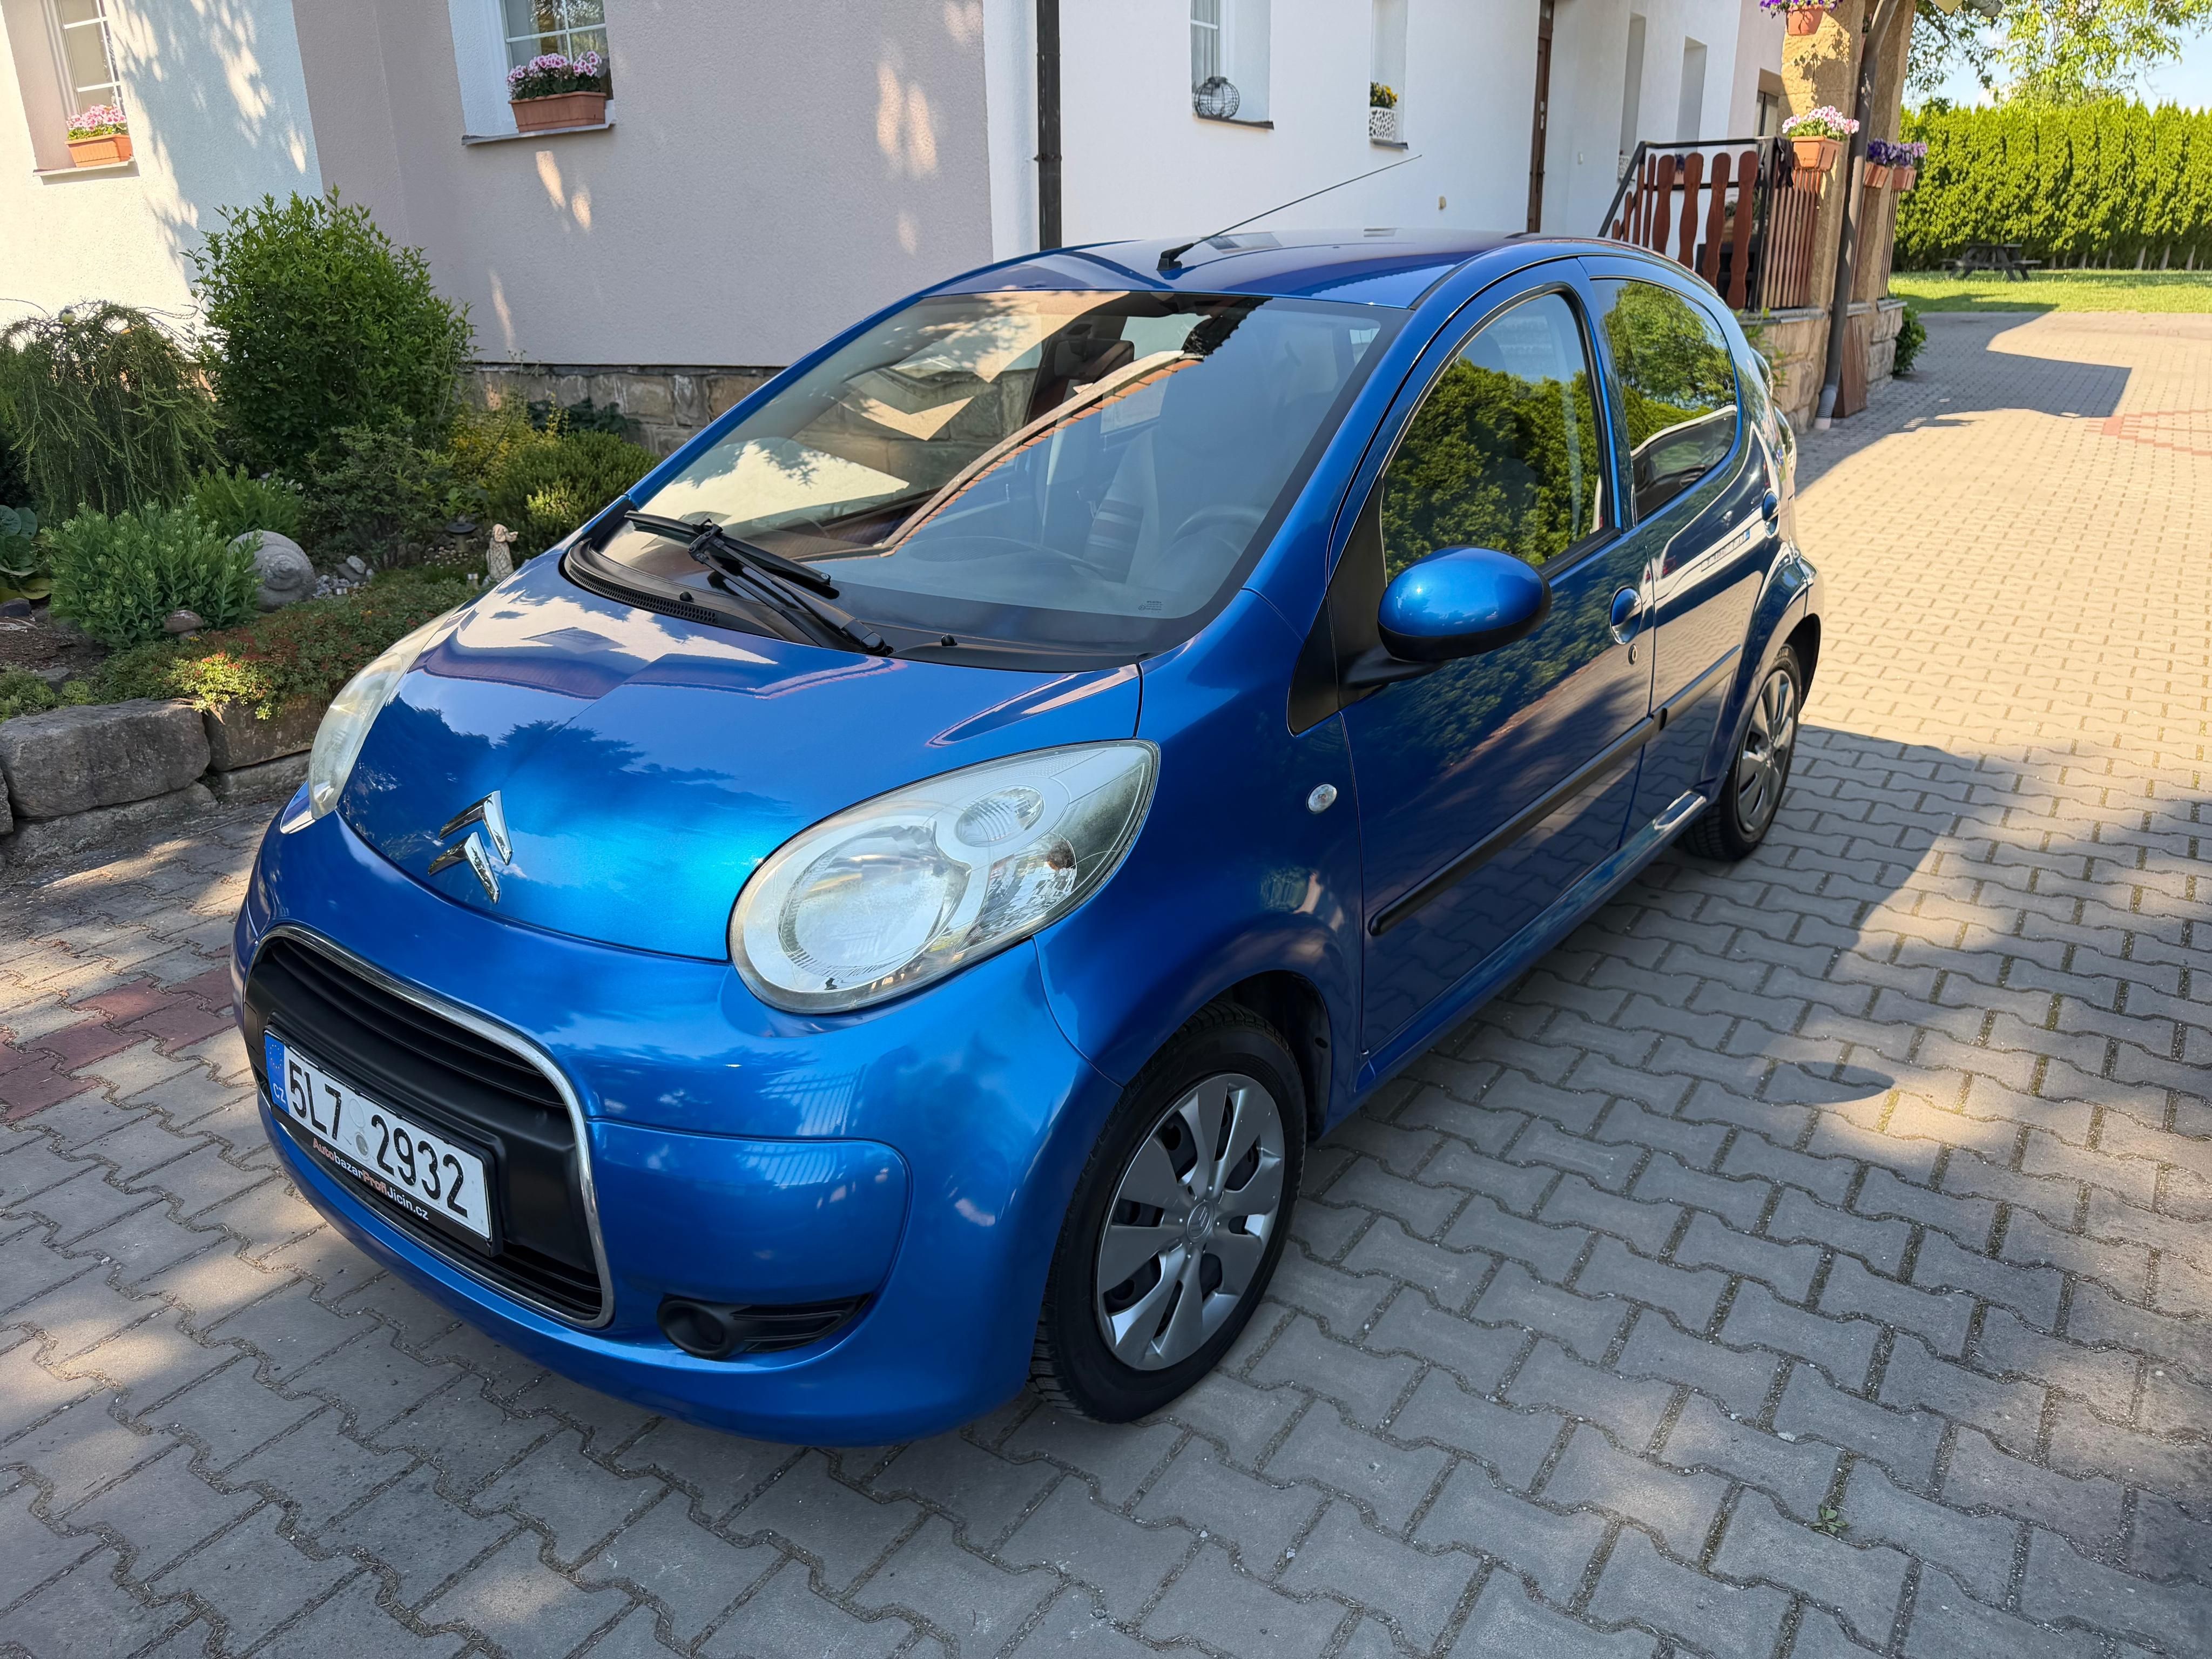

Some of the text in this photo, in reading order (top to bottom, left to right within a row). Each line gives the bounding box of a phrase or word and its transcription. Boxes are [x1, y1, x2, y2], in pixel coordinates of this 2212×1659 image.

[273, 1082, 286, 1104] CZ
[288, 1058, 468, 1218] 5L7 2932
